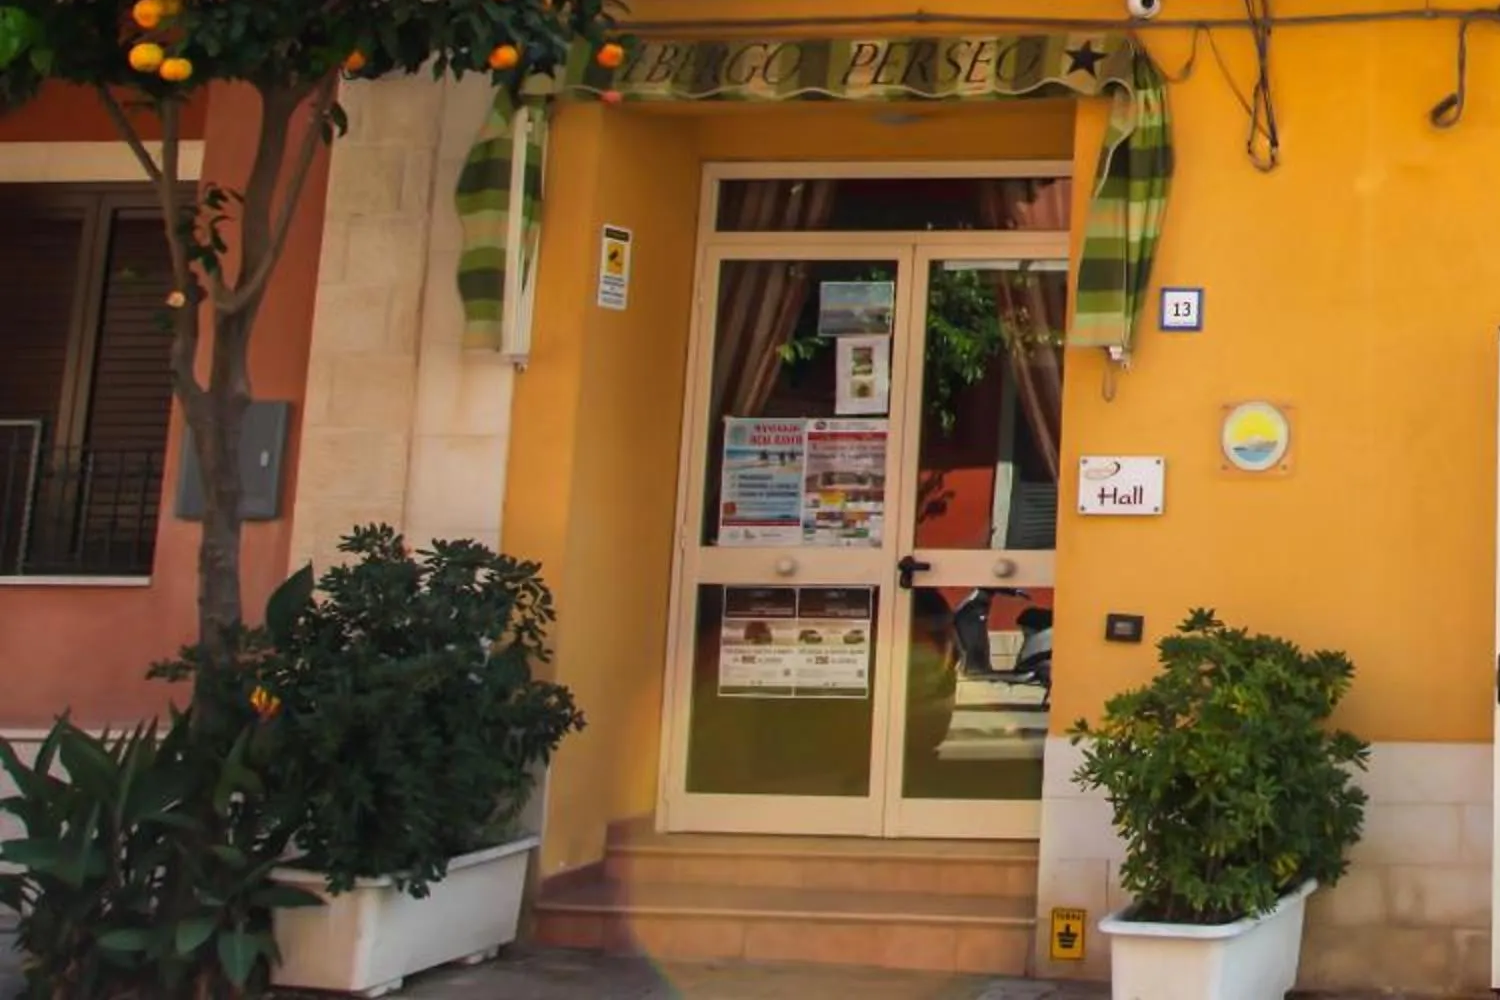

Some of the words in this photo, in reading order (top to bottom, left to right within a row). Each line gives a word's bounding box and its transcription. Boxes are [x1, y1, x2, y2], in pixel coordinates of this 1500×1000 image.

[841, 40, 1046, 86] PERSEO
[1173, 301, 1192, 318] 13
[1097, 484, 1144, 507] Hall
